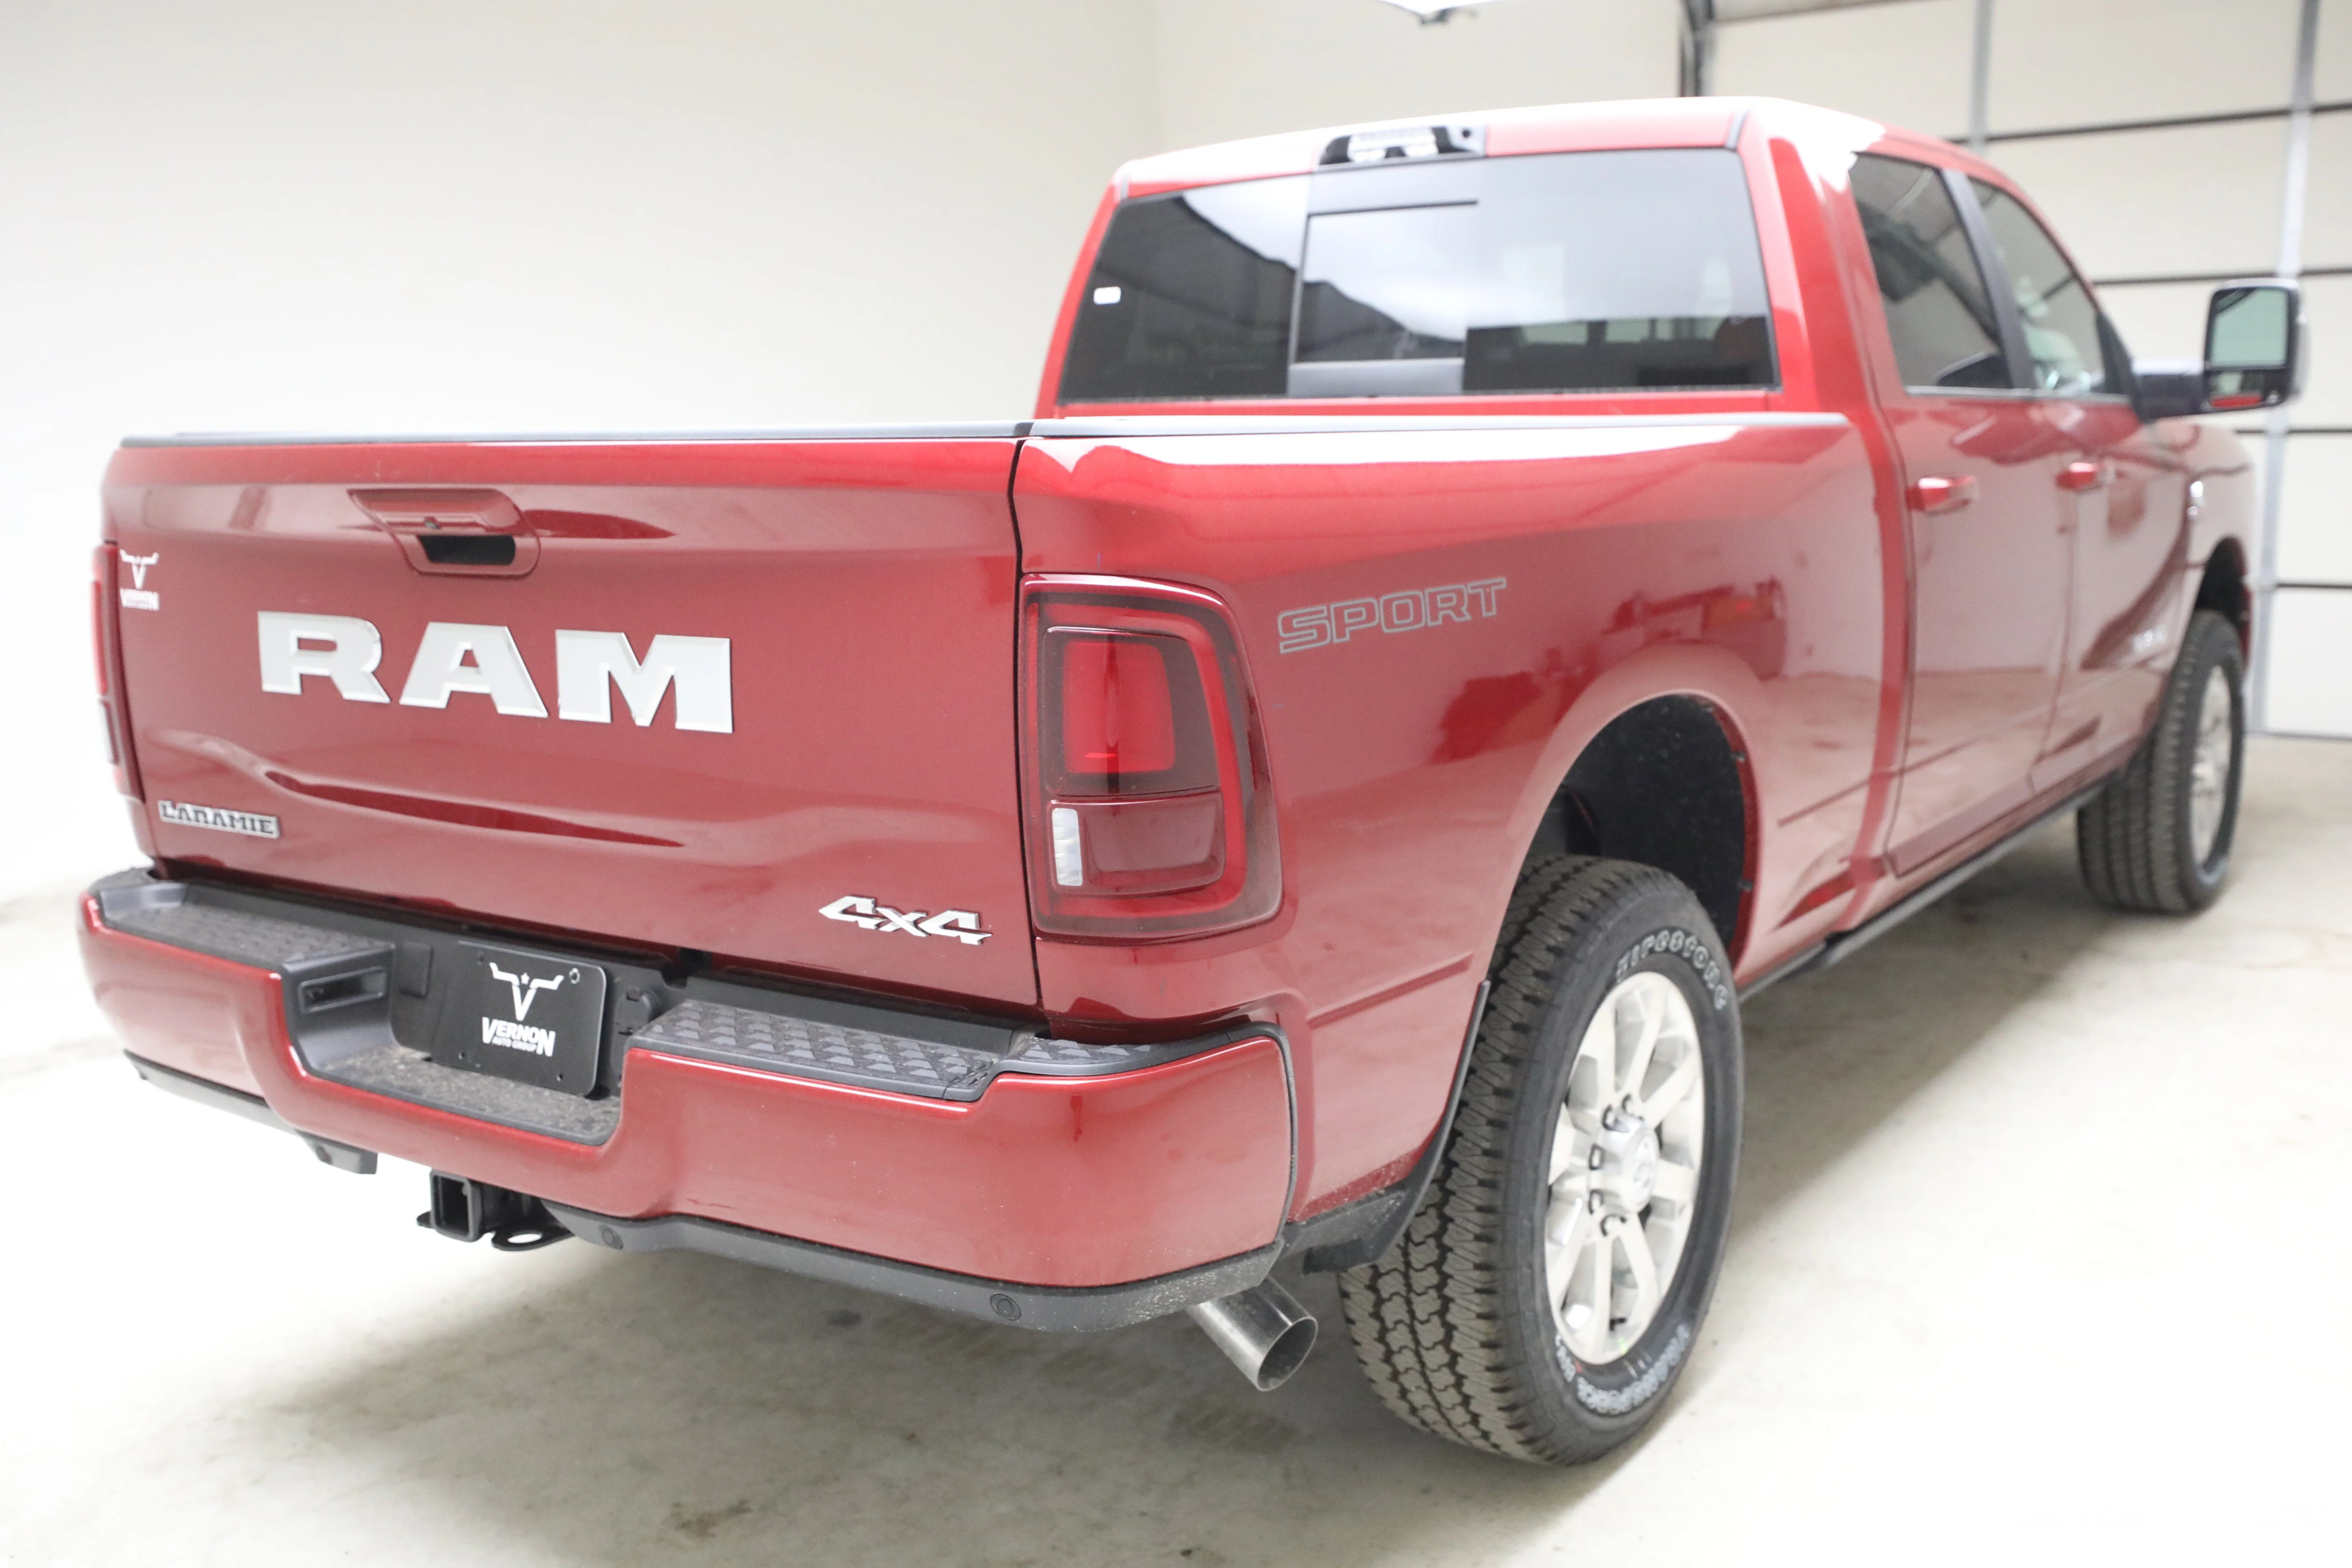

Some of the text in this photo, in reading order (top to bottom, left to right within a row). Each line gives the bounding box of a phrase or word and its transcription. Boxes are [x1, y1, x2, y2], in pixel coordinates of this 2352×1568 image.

[1277, 577, 1506, 654] SPORT
[258, 610, 733, 733] RAM
[160, 802, 277, 837] LARAMIE
[482, 1017, 556, 1057] VERNON
